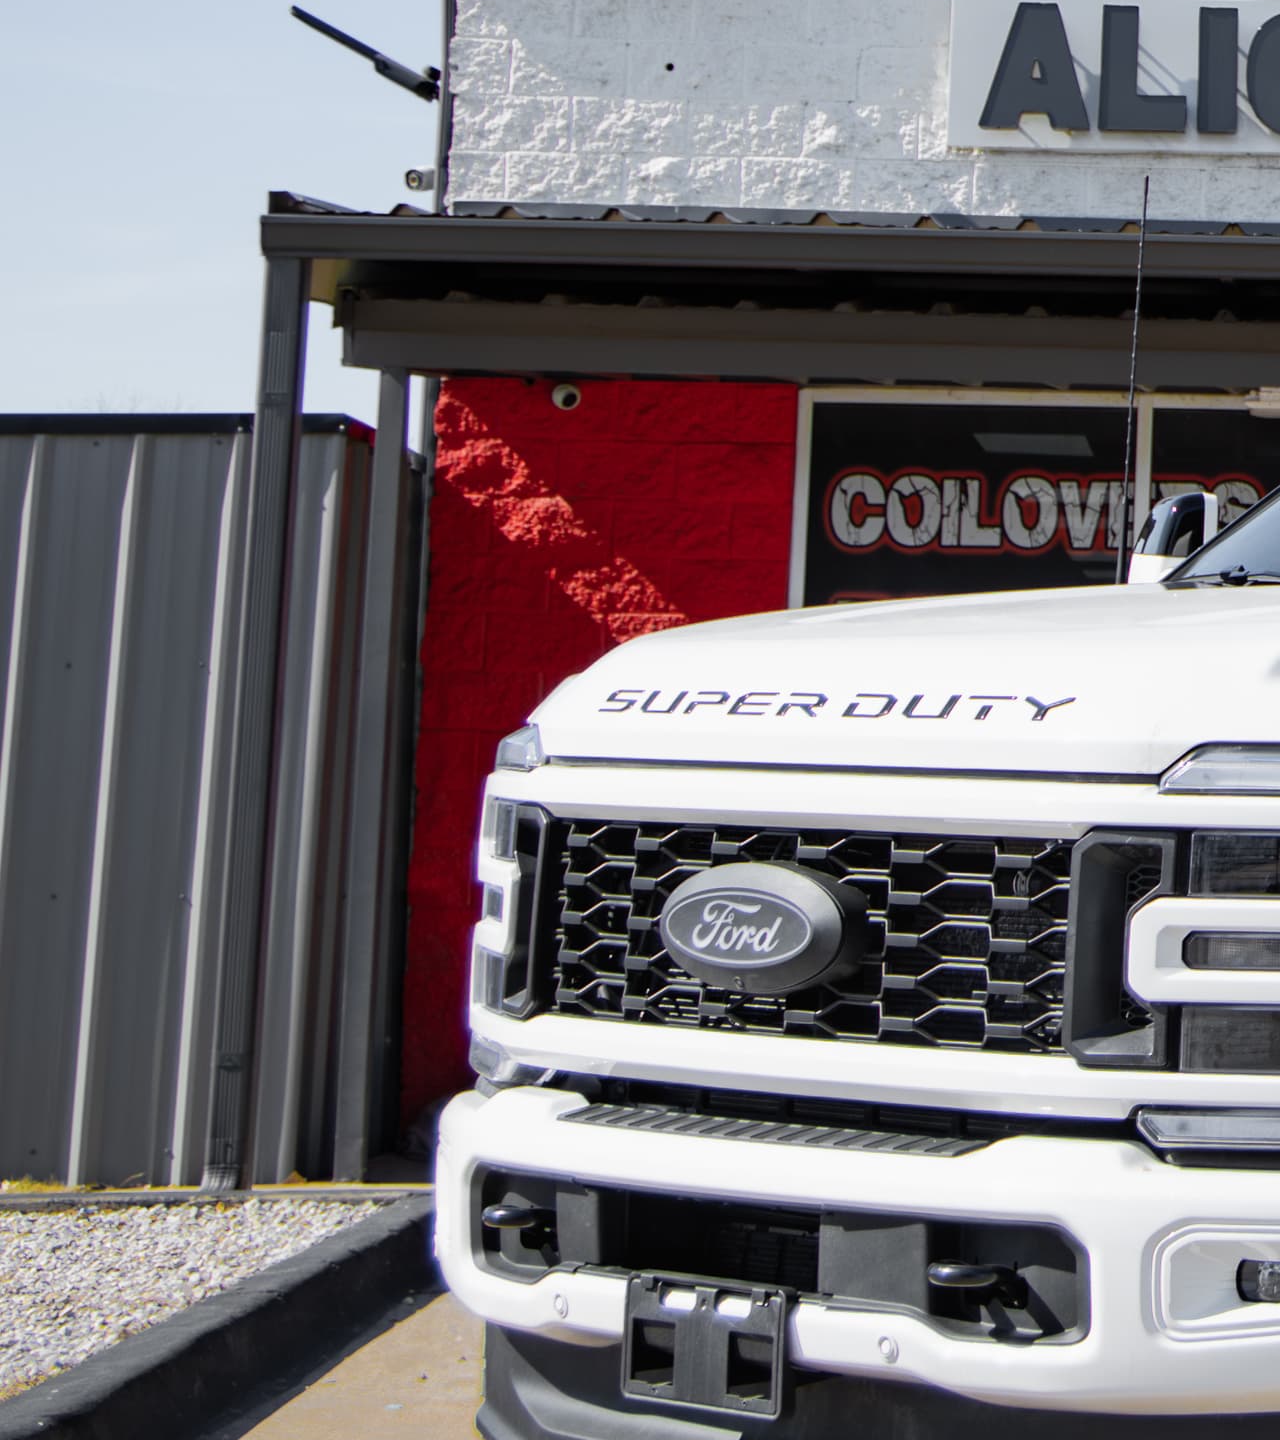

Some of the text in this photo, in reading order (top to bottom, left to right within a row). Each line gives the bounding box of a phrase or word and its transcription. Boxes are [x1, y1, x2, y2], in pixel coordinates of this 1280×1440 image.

[598, 689, 1077, 721] SUPER DUTY
[692, 899, 783, 953] Ford
